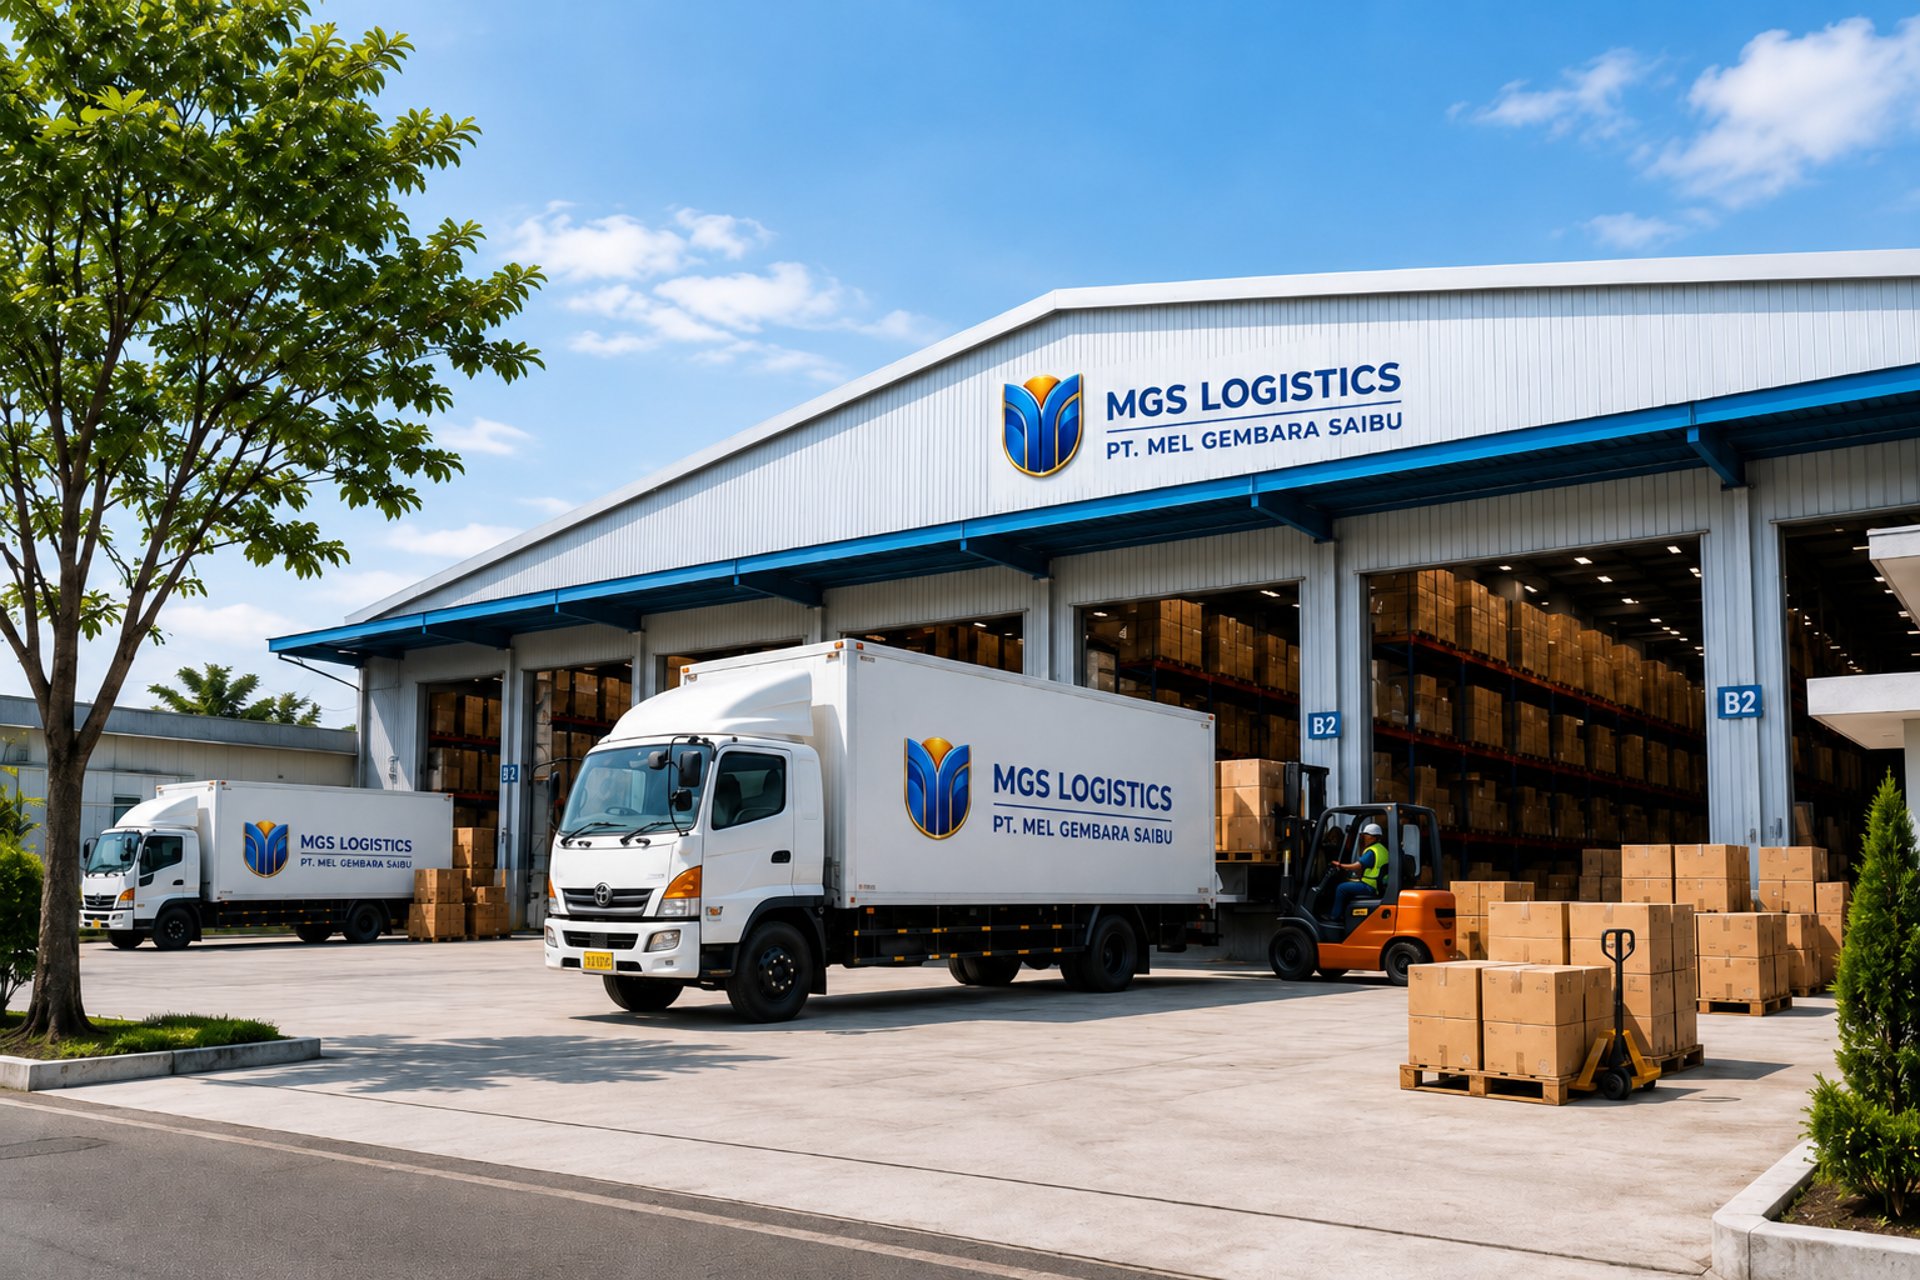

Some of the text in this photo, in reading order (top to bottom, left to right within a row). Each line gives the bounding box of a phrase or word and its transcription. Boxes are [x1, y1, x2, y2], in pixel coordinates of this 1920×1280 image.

[1107, 362, 1401, 421] MGS LOGISTICS
[1107, 412, 1402, 460] PT. MEL GEMBARA SAIBU
[1724, 690, 1756, 714] B2
[1313, 716, 1336, 735] B2
[993, 763, 1172, 811] MGS LOGISTICS
[301, 834, 412, 852] MGS LOGISTICS
[993, 815, 1172, 845] PT. MEL GEMBARA SAIBU
[301, 858, 412, 869] PT. MEL GEMBARA SAIBU
